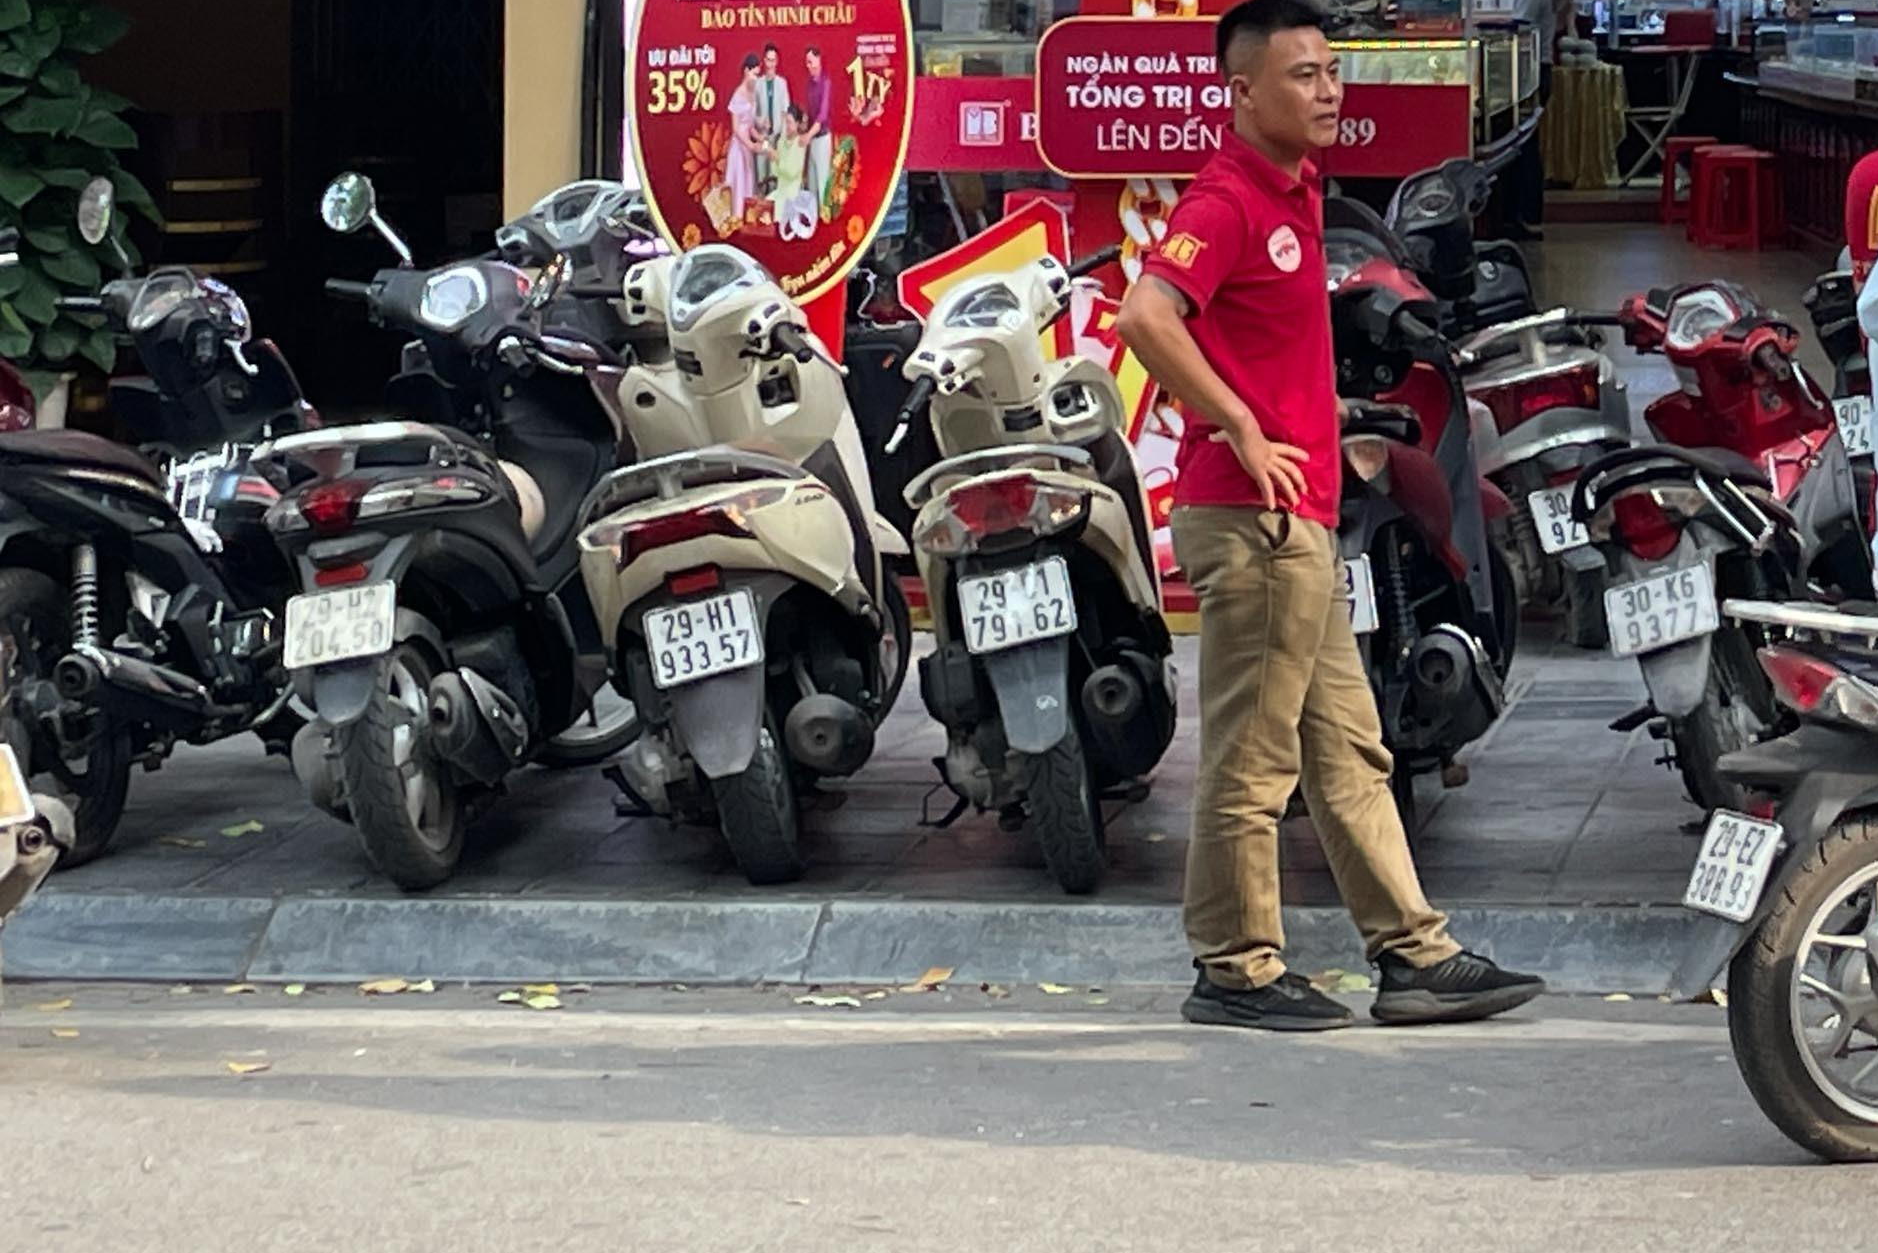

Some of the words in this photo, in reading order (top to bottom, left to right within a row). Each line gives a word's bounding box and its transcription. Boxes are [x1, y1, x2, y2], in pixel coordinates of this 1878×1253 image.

[1066, 51, 1129, 75] NGÀN
[1134, 48, 1181, 75] QUÀ
[1186, 54, 1217, 75] TRI
[646, 66, 717, 116] 35%
[1066, 77, 1147, 109] TỔNG
[1152, 84, 1193, 114] TRỊ
[1200, 86, 1232, 110] GI
[1096, 118, 1152, 151] LÊN
[1158, 114, 1224, 151] ĐẾN
[1339, 116, 1377, 147] 89
[1846, 428, 1870, 453] 24
[1543, 491, 1569, 519] 30
[1551, 517, 1581, 546] 92
[1621, 572, 1697, 620] 30-K6
[662, 596, 738, 644] 29-H1
[1627, 602, 1700, 650] 9377
